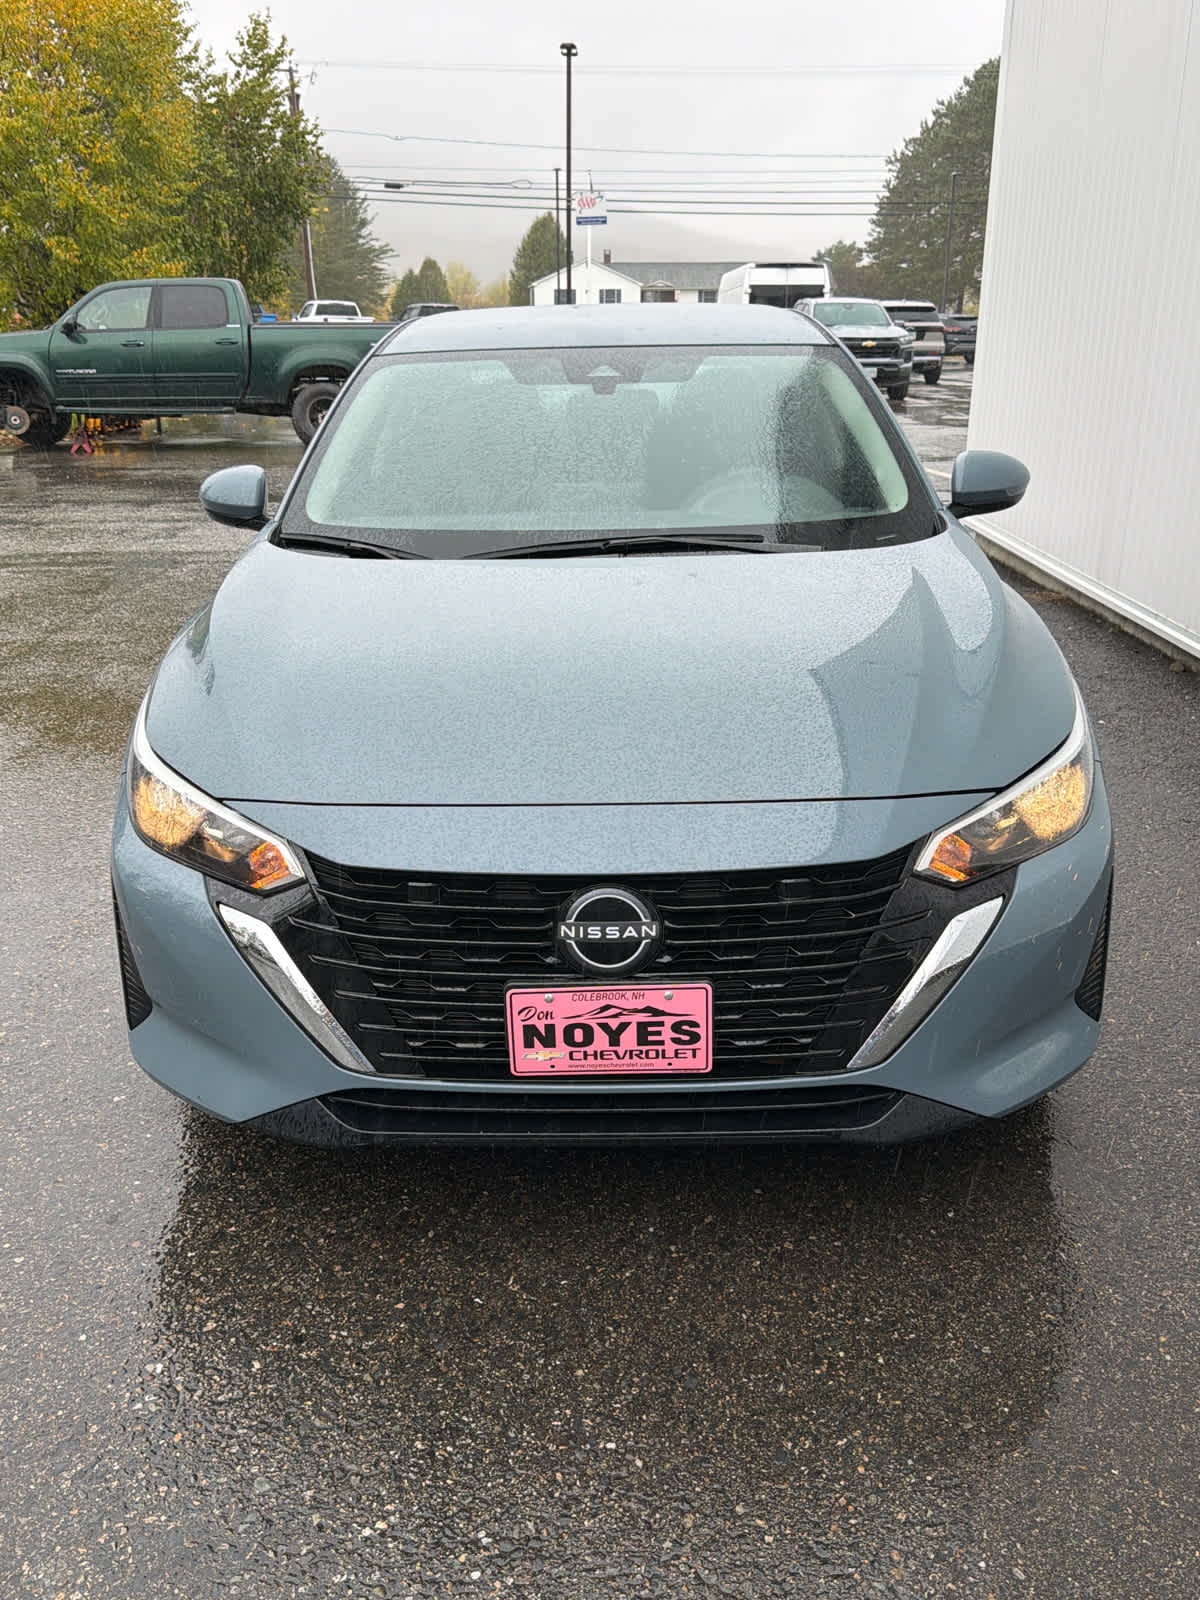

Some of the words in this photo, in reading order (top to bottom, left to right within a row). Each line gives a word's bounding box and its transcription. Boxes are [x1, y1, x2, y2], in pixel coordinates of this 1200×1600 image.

[560, 924, 657, 938] NISSAN
[571, 993, 629, 1002] COLEBROOK,
[631, 992, 646, 1000] NH
[517, 1006, 555, 1022] Don
[522, 1020, 702, 1048] NOYES
[568, 1048, 701, 1061] CHEVROLET
